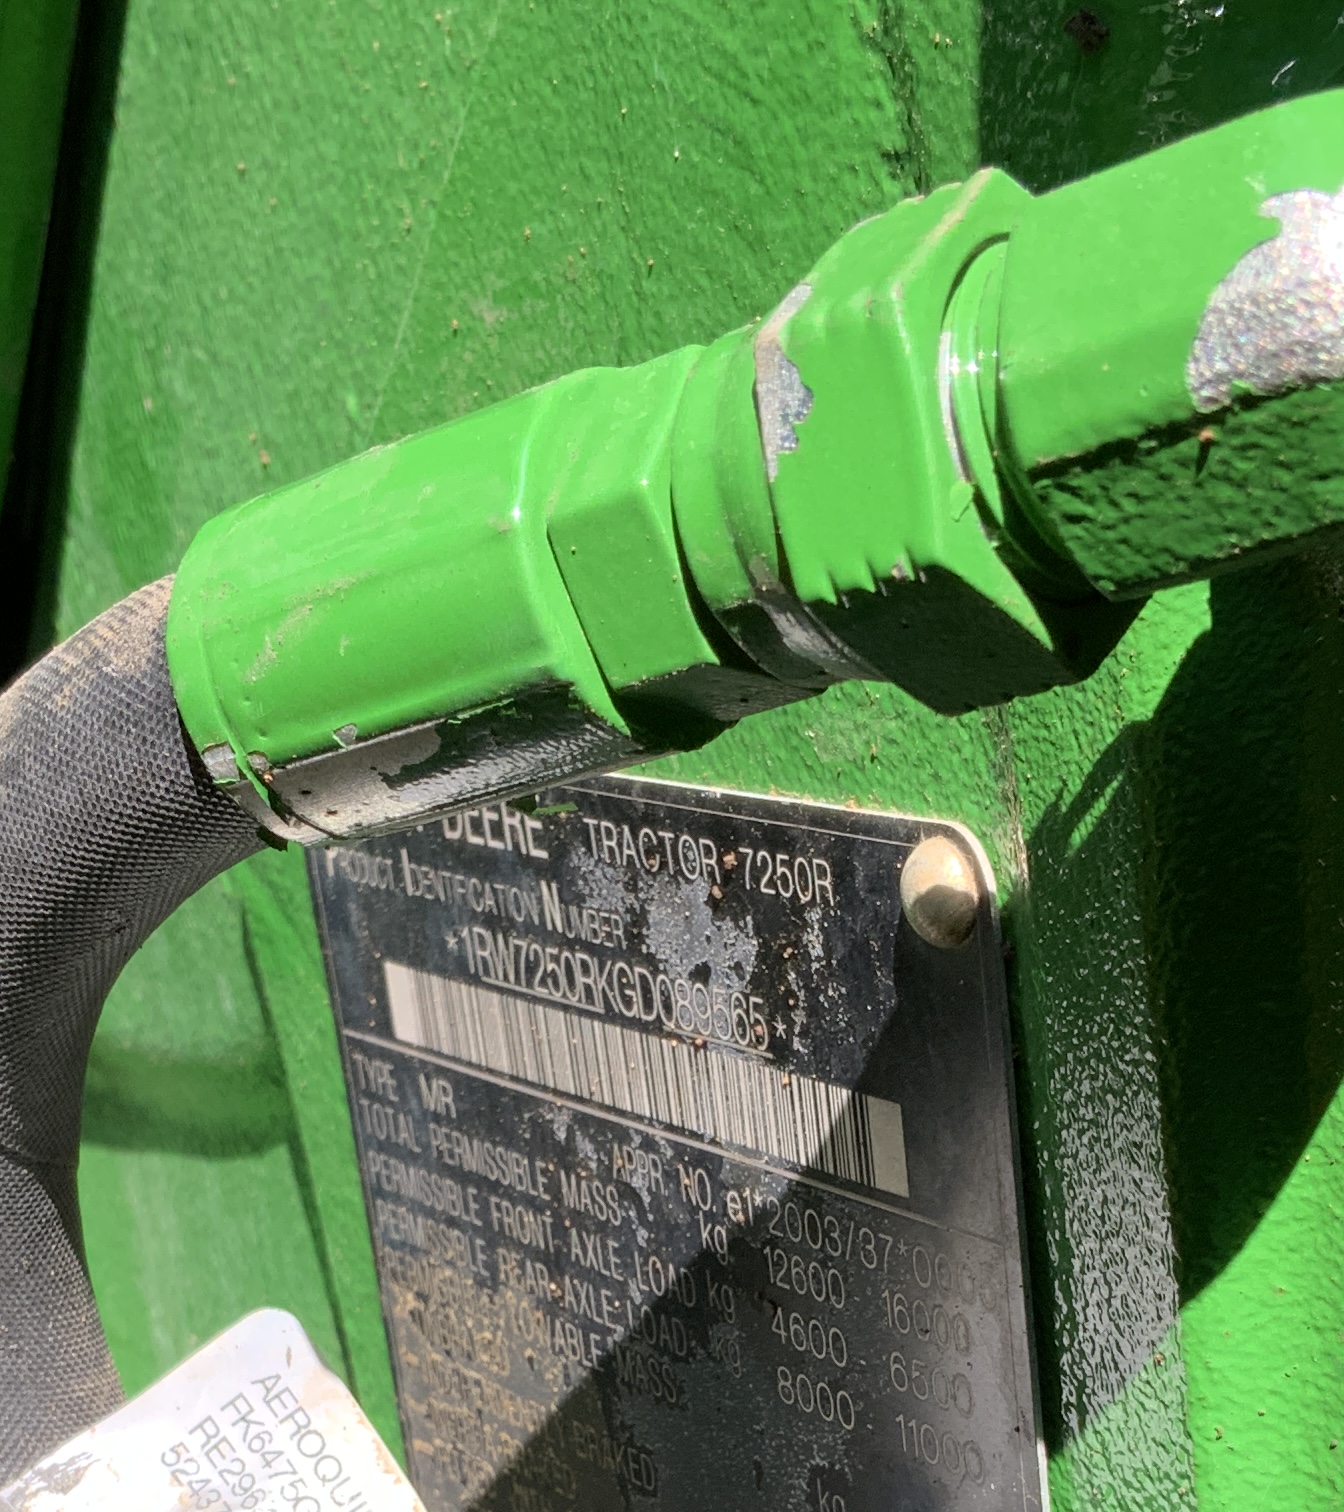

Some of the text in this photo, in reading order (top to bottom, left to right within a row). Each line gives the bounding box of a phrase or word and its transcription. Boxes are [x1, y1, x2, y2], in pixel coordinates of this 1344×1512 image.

[441, 802, 835, 906] DEERE TRACTOR 7250R
[351, 1053, 400, 1101] TYPE
[419, 1073, 457, 1119] MR
[676, 1163, 717, 1213] NO.
[358, 1098, 971, 1356] TOTAL PERMISSIBLE MASS kg 12600 16000
[368, 1150, 975, 1419] PERMISSIBLE FRONT AXLE LOAD kg 4600 6500
[563, 1275, 620, 1331] AXLE
[626, 1300, 687, 1356] LOAD
[776, 1365, 855, 1431] 8000
[895, 1413, 984, 1480] 11000
[615, 1342, 678, 1403] MASS
